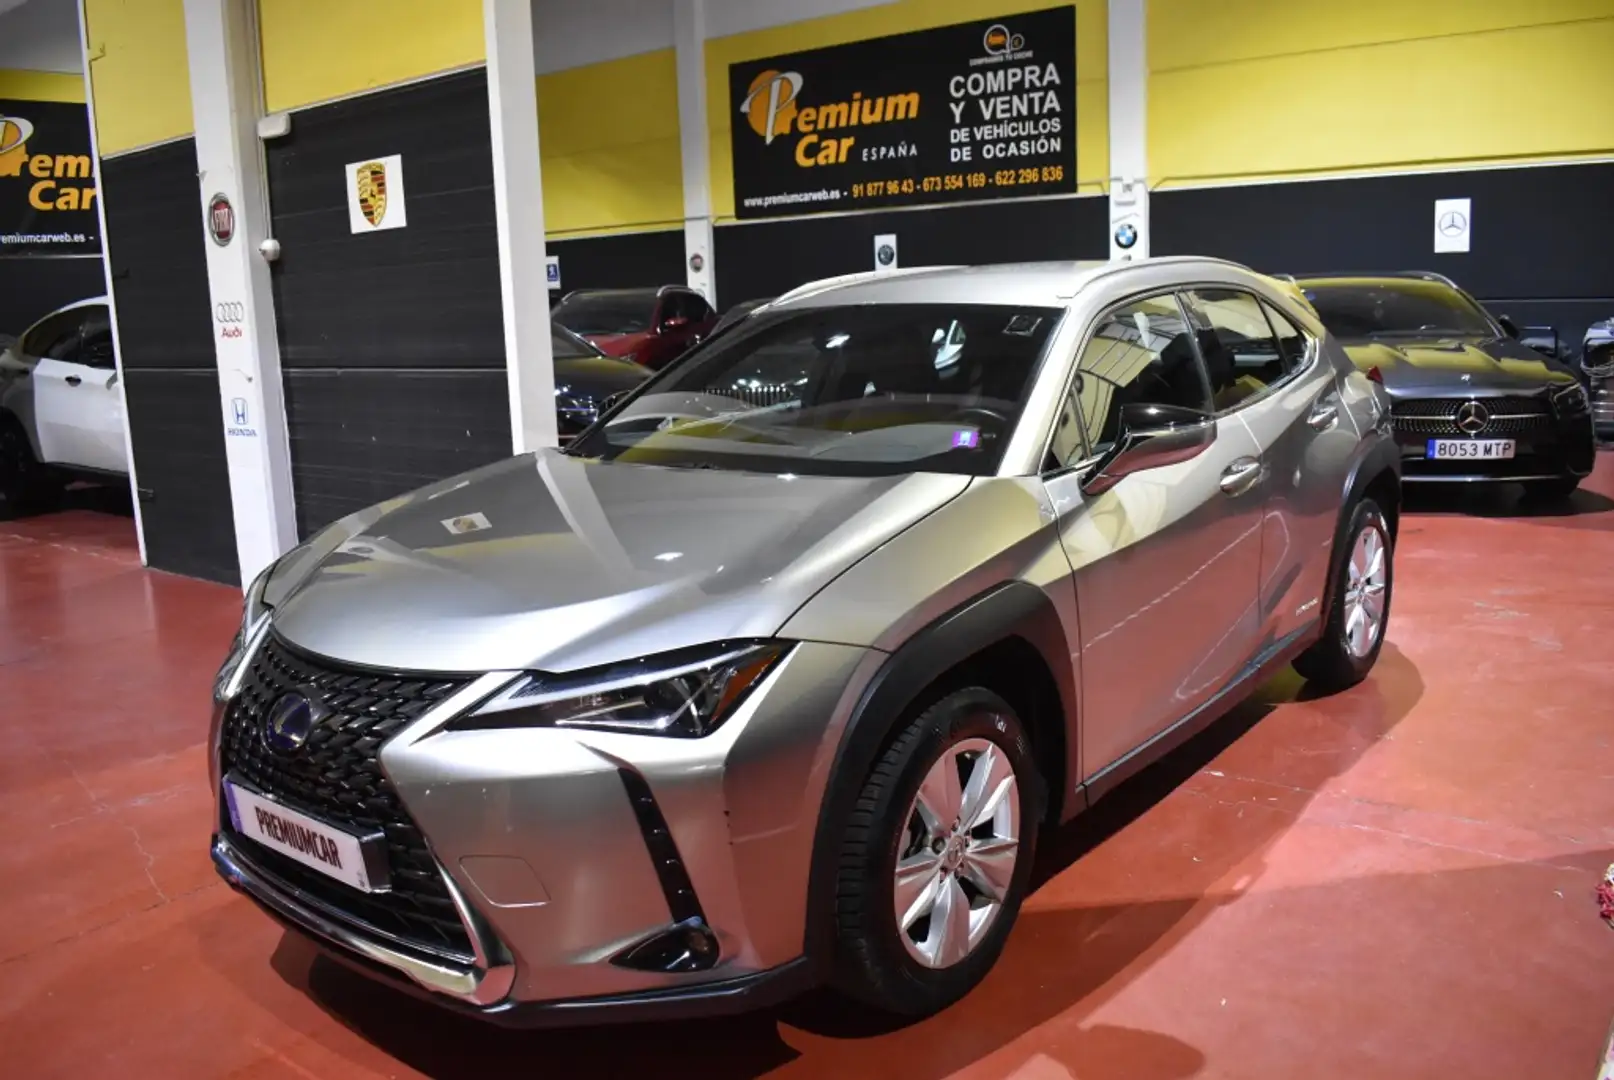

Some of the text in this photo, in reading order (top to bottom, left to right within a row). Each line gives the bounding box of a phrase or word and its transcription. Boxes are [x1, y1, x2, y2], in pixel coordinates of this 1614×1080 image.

[949, 62, 1060, 98] COMPRA
[740, 71, 919, 145] Premium
[949, 90, 1061, 124] Y VENTA
[950, 117, 1061, 143] DE VEHÍCULOS
[795, 134, 918, 167] Car ESPAÑA
[950, 136, 1061, 162] DE OCASIÓN
[28, 179, 96, 211] Car
[744, 188, 840, 208] www.premiumcarweb.es
[852, 183, 864, 198] 91
[867, 181, 884, 196] 877
[901, 178, 914, 193] 43
[923, 175, 942, 192] 673
[944, 174, 963, 190] 554
[966, 172, 986, 188] 169
[995, 170, 1017, 186] 622
[1018, 168, 1039, 184] 296
[0, 232, 86, 244] emiumcarweb.es
[221, 326, 242, 338] Audi
[1438, 442, 1512, 457] 8053 MTP
[254, 805, 343, 870] PREMIUMCAR
